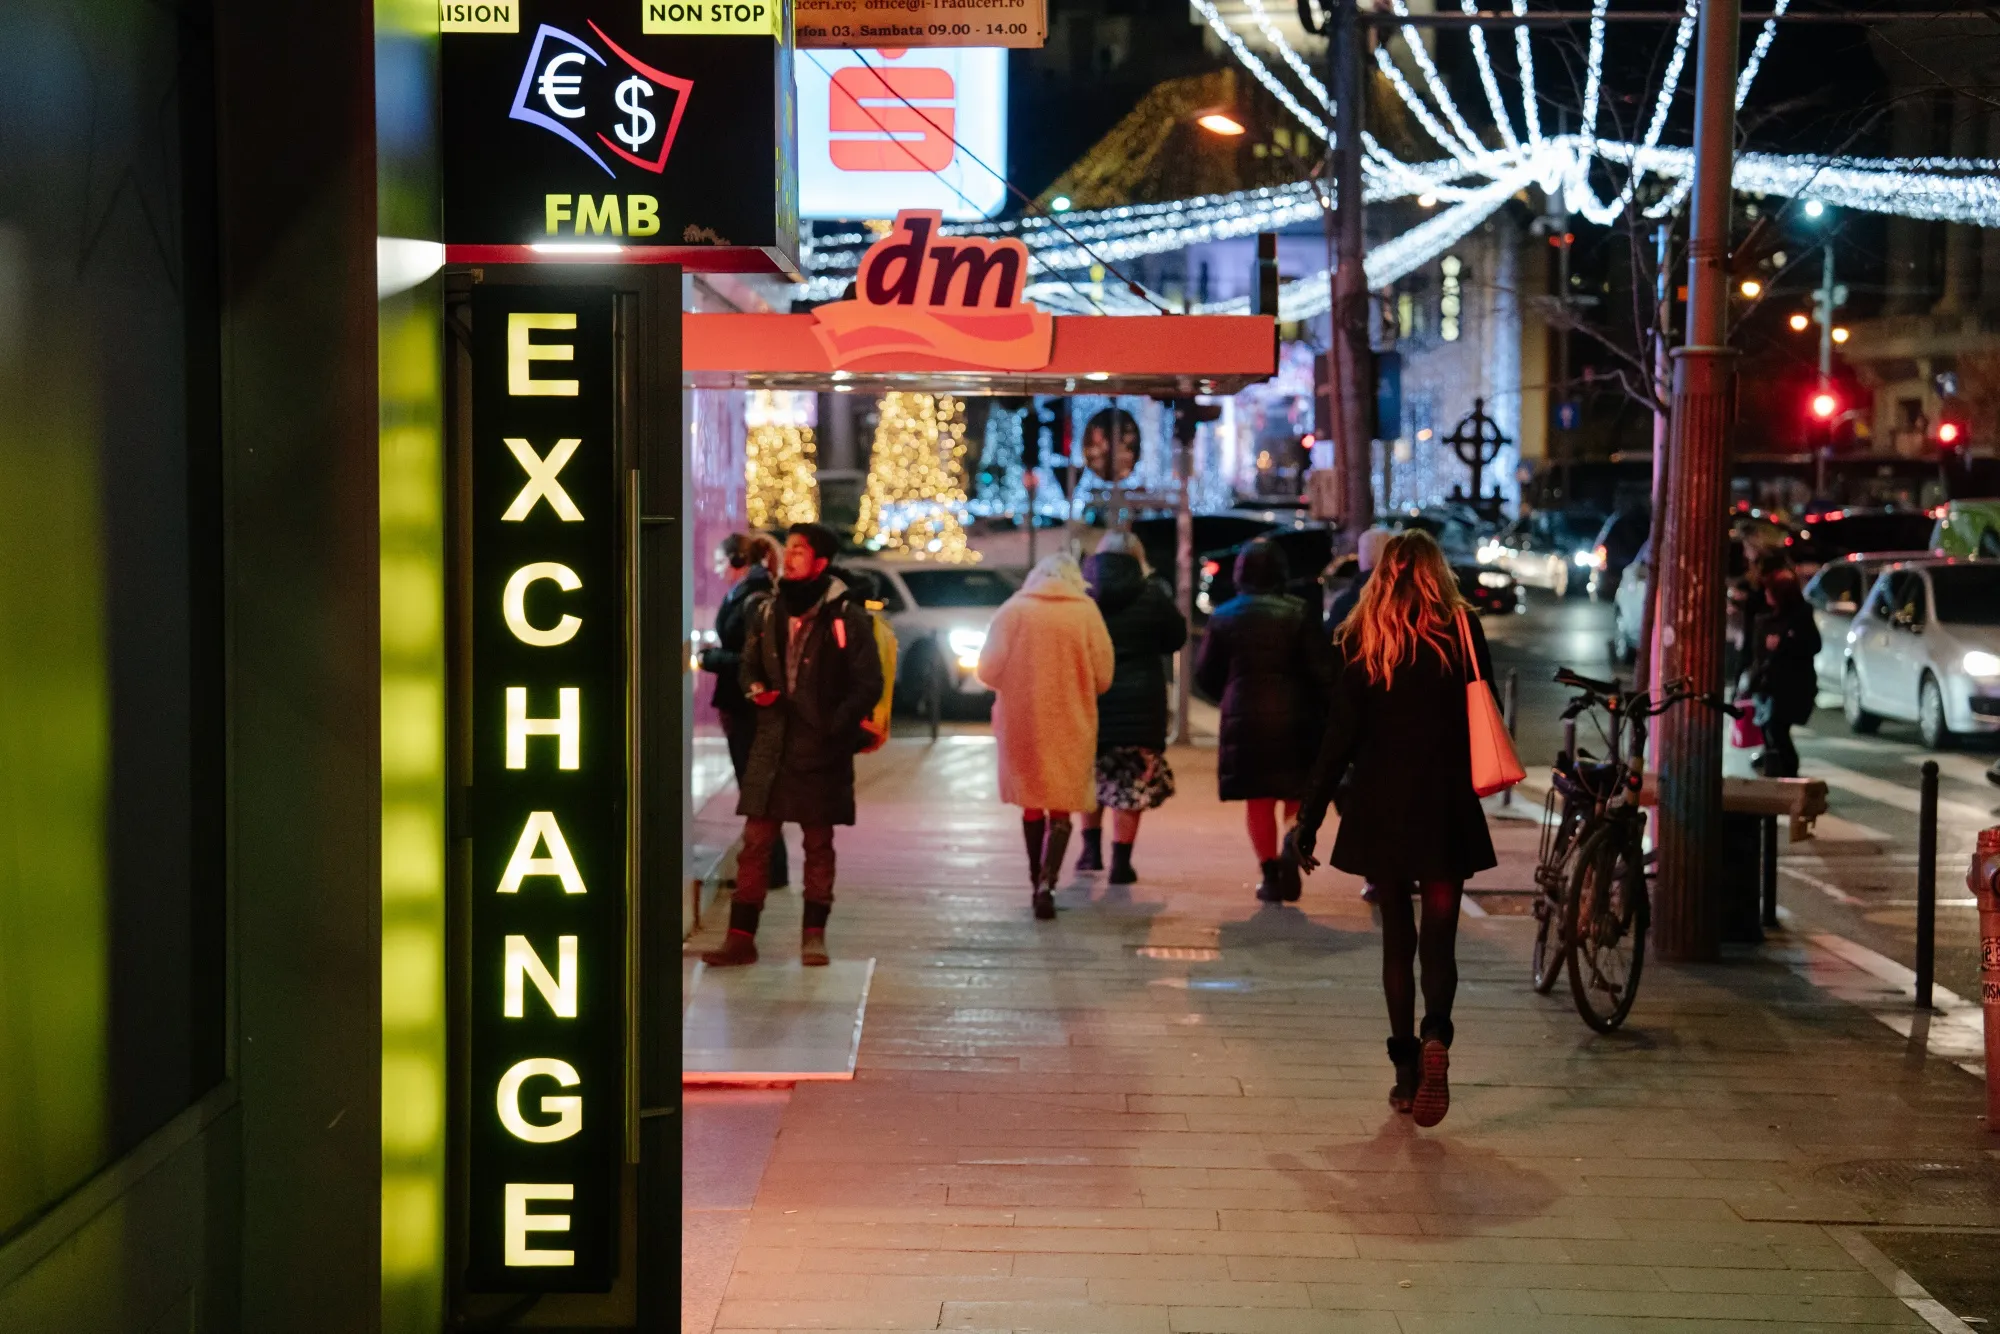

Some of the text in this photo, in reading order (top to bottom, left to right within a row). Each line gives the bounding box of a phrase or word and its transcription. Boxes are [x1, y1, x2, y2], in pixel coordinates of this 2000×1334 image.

[441, 5, 509, 22] ISION
[650, 4, 702, 22] NON
[711, 4, 765, 22] STOP
[860, 25, 924, 37] Sambata
[928, 24, 970, 36] 09.00
[986, 23, 1028, 35] 14.00
[546, 194, 660, 237] FMB
[866, 217, 1020, 308] dm
[496, 313, 586, 1267] EXCHANGE
